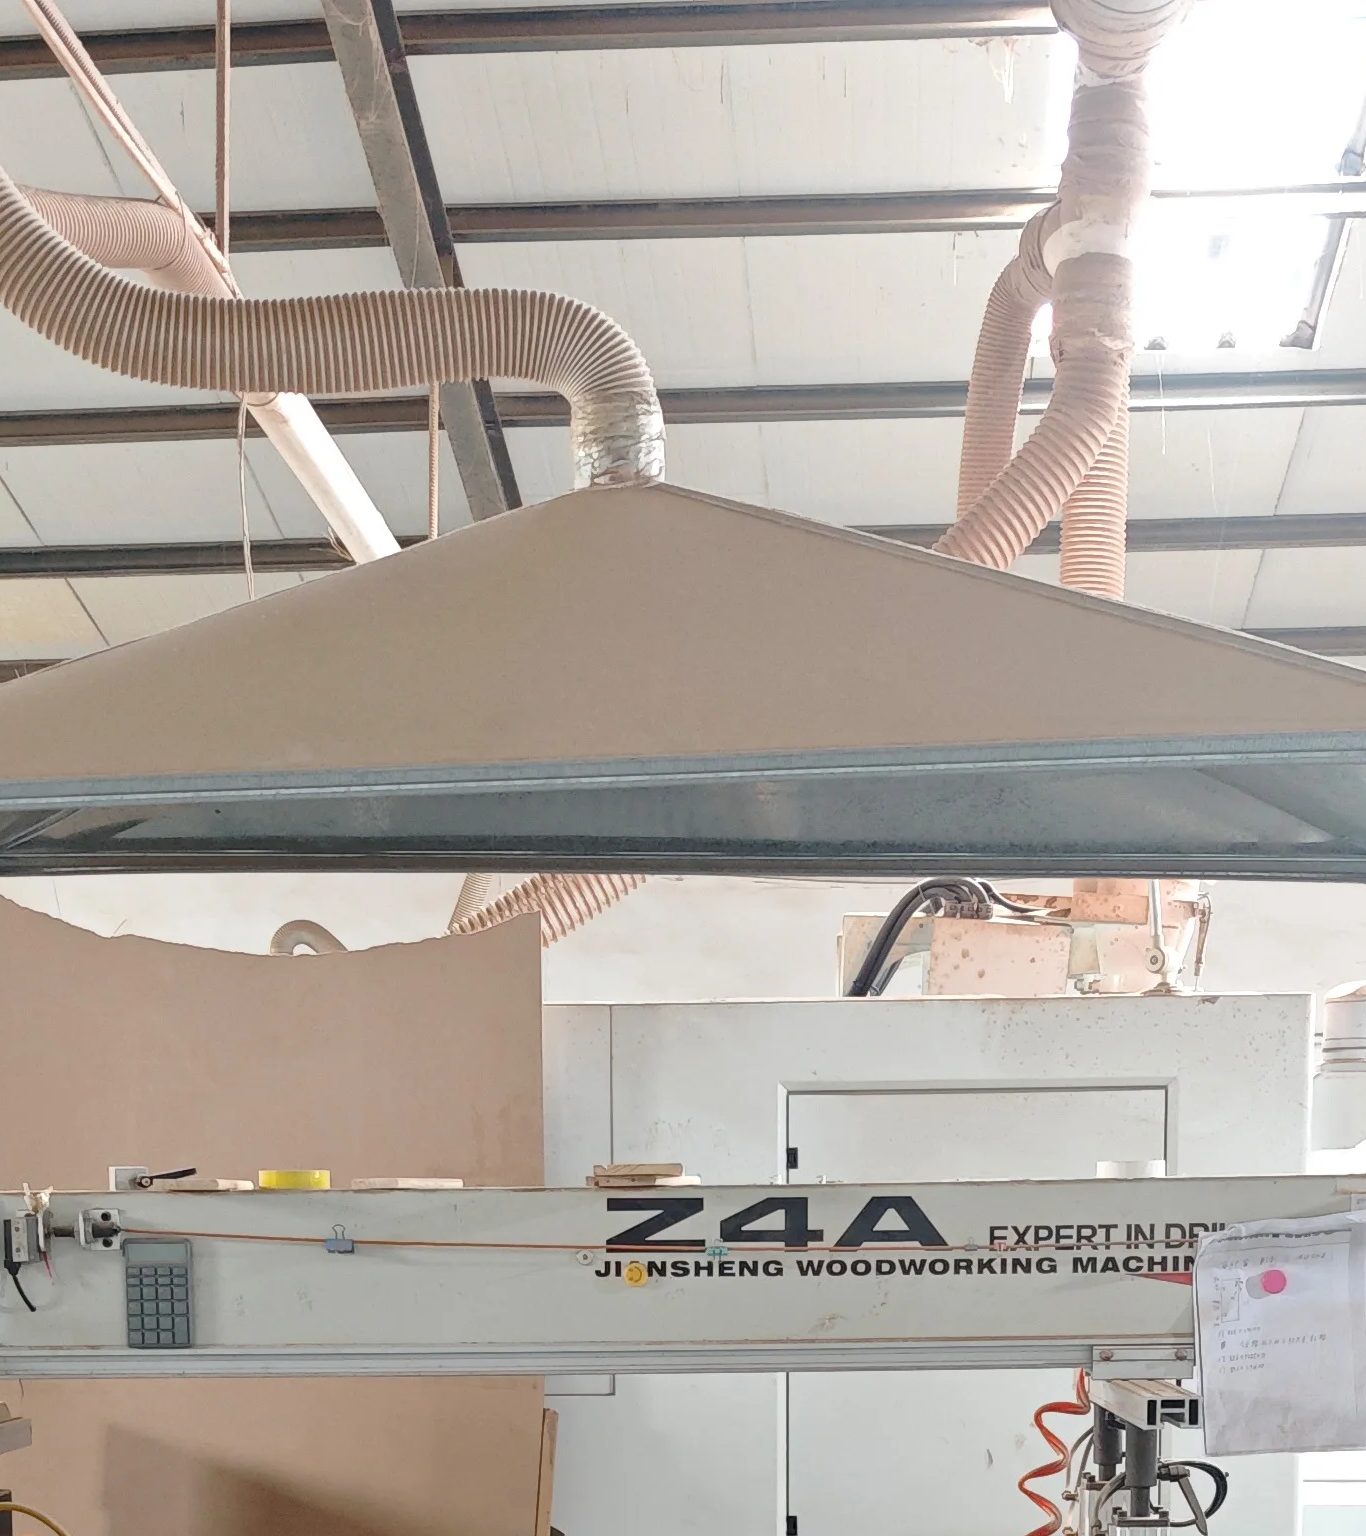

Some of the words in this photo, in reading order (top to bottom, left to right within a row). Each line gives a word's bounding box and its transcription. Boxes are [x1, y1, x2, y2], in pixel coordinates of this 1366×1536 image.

[605, 1196, 953, 1253] Z4A
[989, 1223, 1119, 1252] EXPERT
[1126, 1223, 1155, 1250] IN
[595, 1259, 784, 1277] JINSHENG
[796, 1257, 1058, 1276] WOODWORKING
